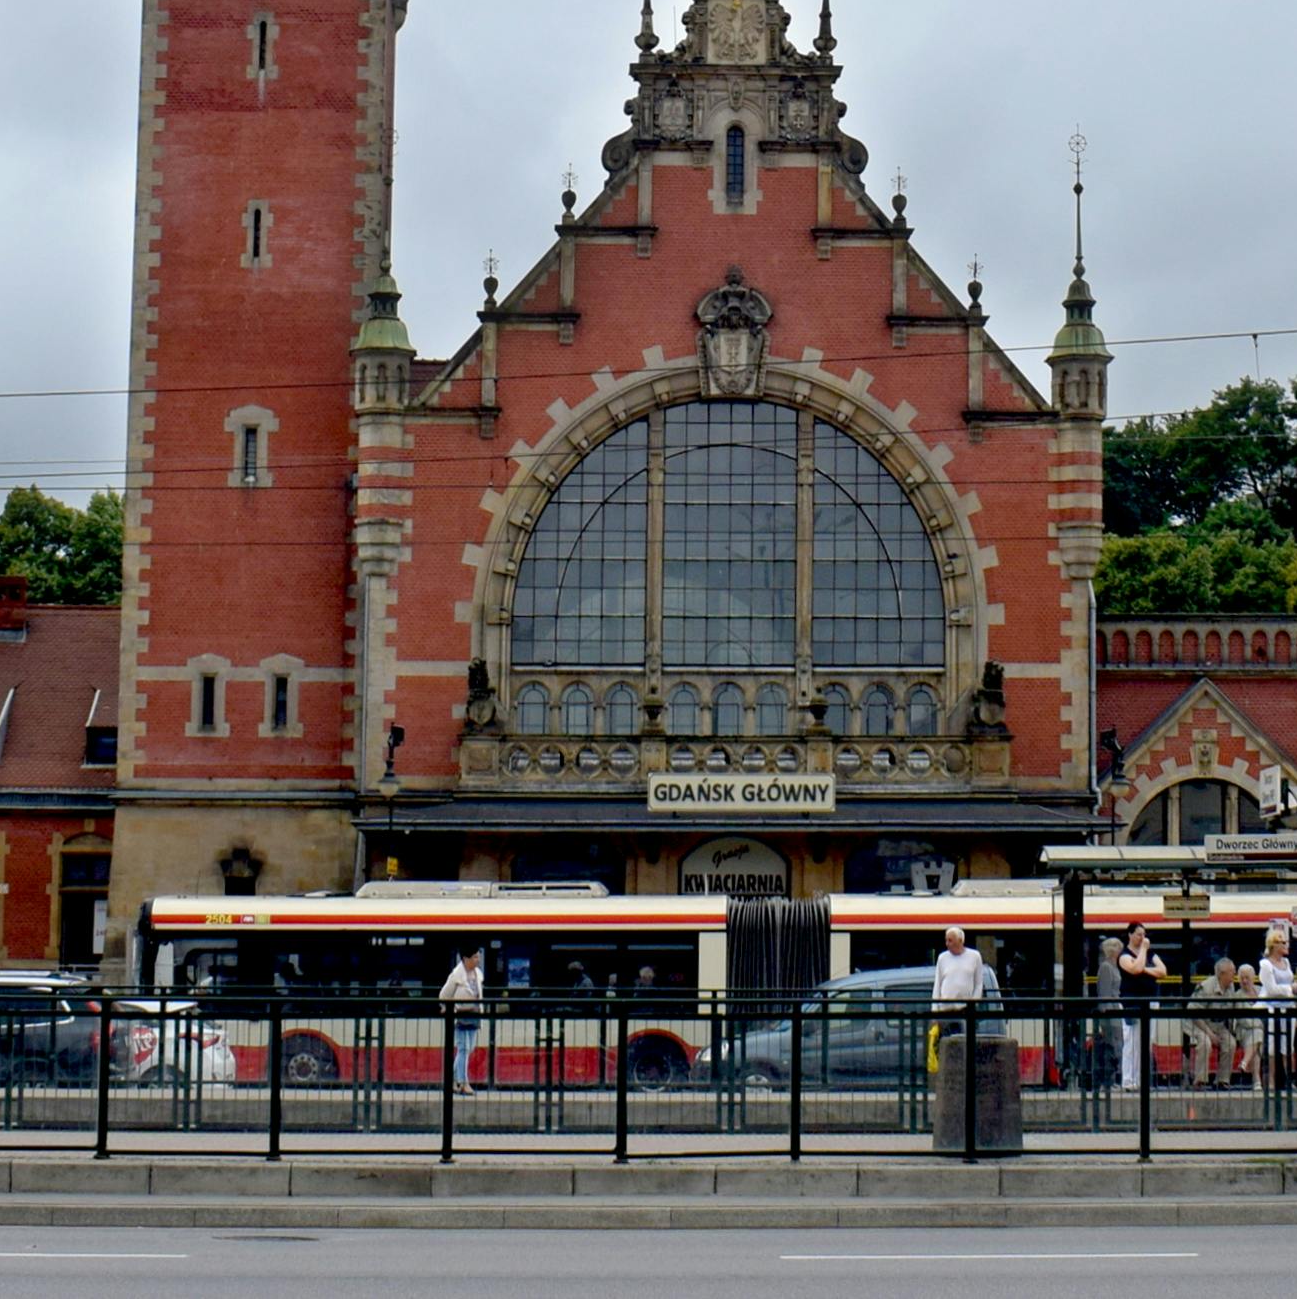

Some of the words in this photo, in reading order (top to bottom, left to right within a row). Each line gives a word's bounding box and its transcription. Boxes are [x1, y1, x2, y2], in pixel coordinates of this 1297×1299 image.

[654, 778, 735, 802] GDAŃSK
[742, 778, 829, 802] GŁÓWNY
[1216, 838, 1259, 850] Dworzec
[684, 873, 784, 893] KWIACIARNIA
[206, 914, 232, 924] 2504
